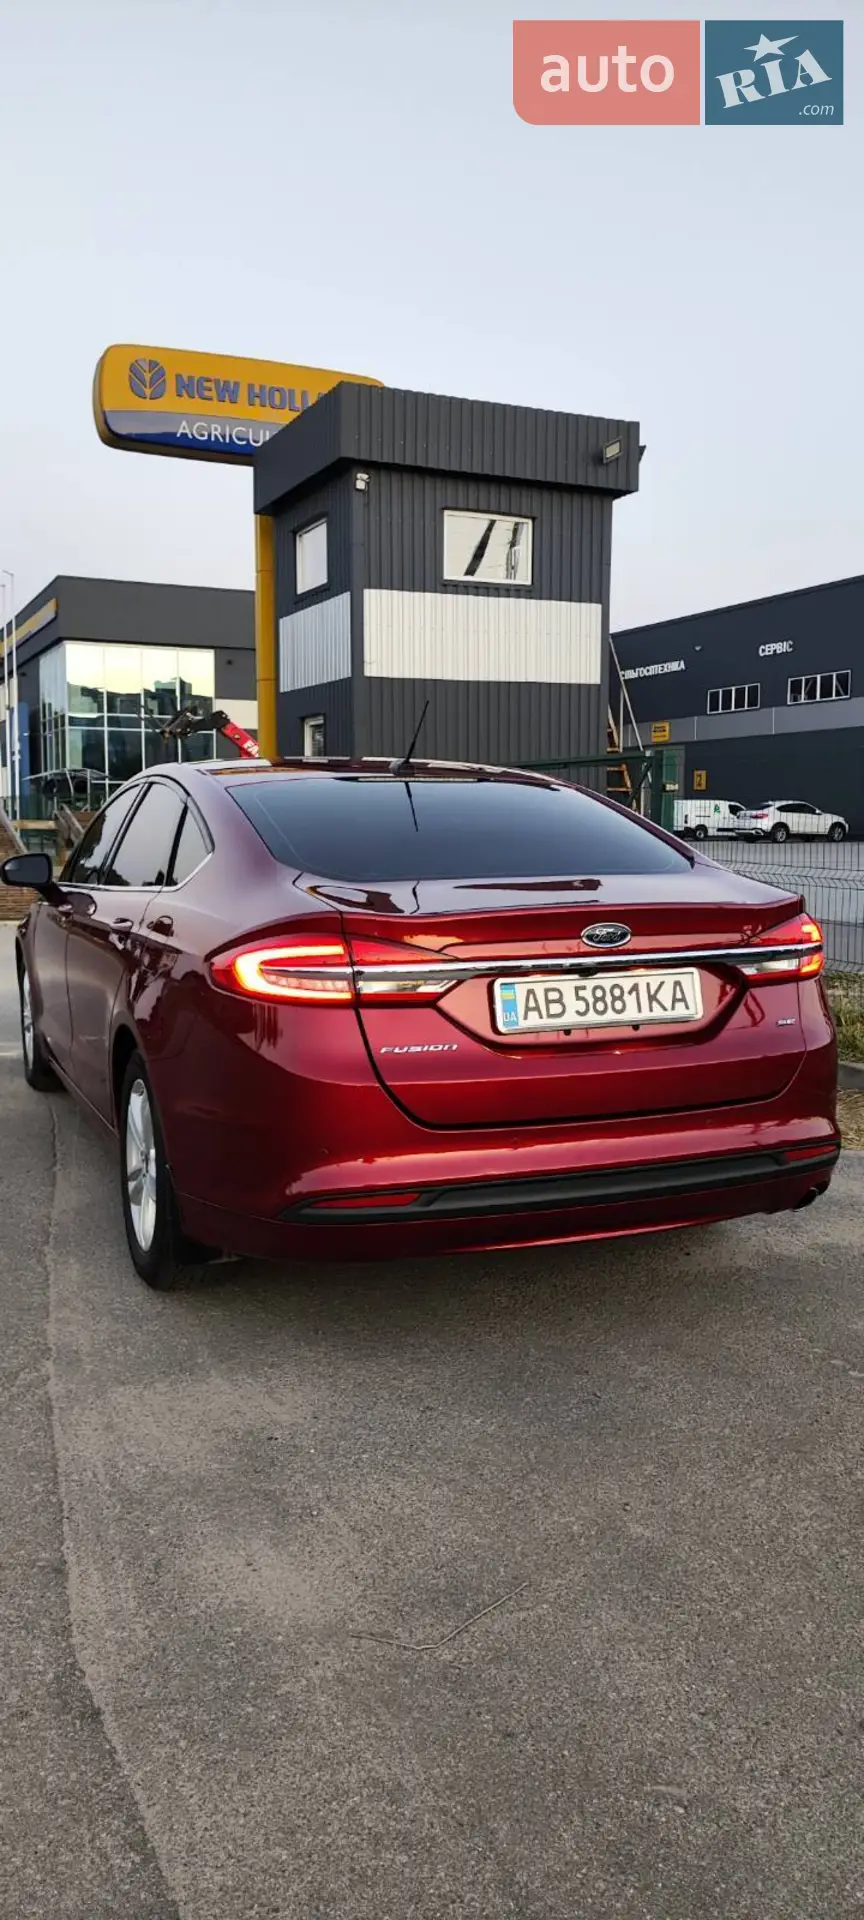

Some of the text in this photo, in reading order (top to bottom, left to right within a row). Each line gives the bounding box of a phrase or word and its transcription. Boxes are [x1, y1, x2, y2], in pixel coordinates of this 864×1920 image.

[175, 373, 240, 404] NEW
[758, 640, 794, 657] СЕРВІС
[522, 980, 690, 1021] AB 5881 KA
[503, 1011, 517, 1023] UA
[380, 1043, 458, 1054] FUSION
